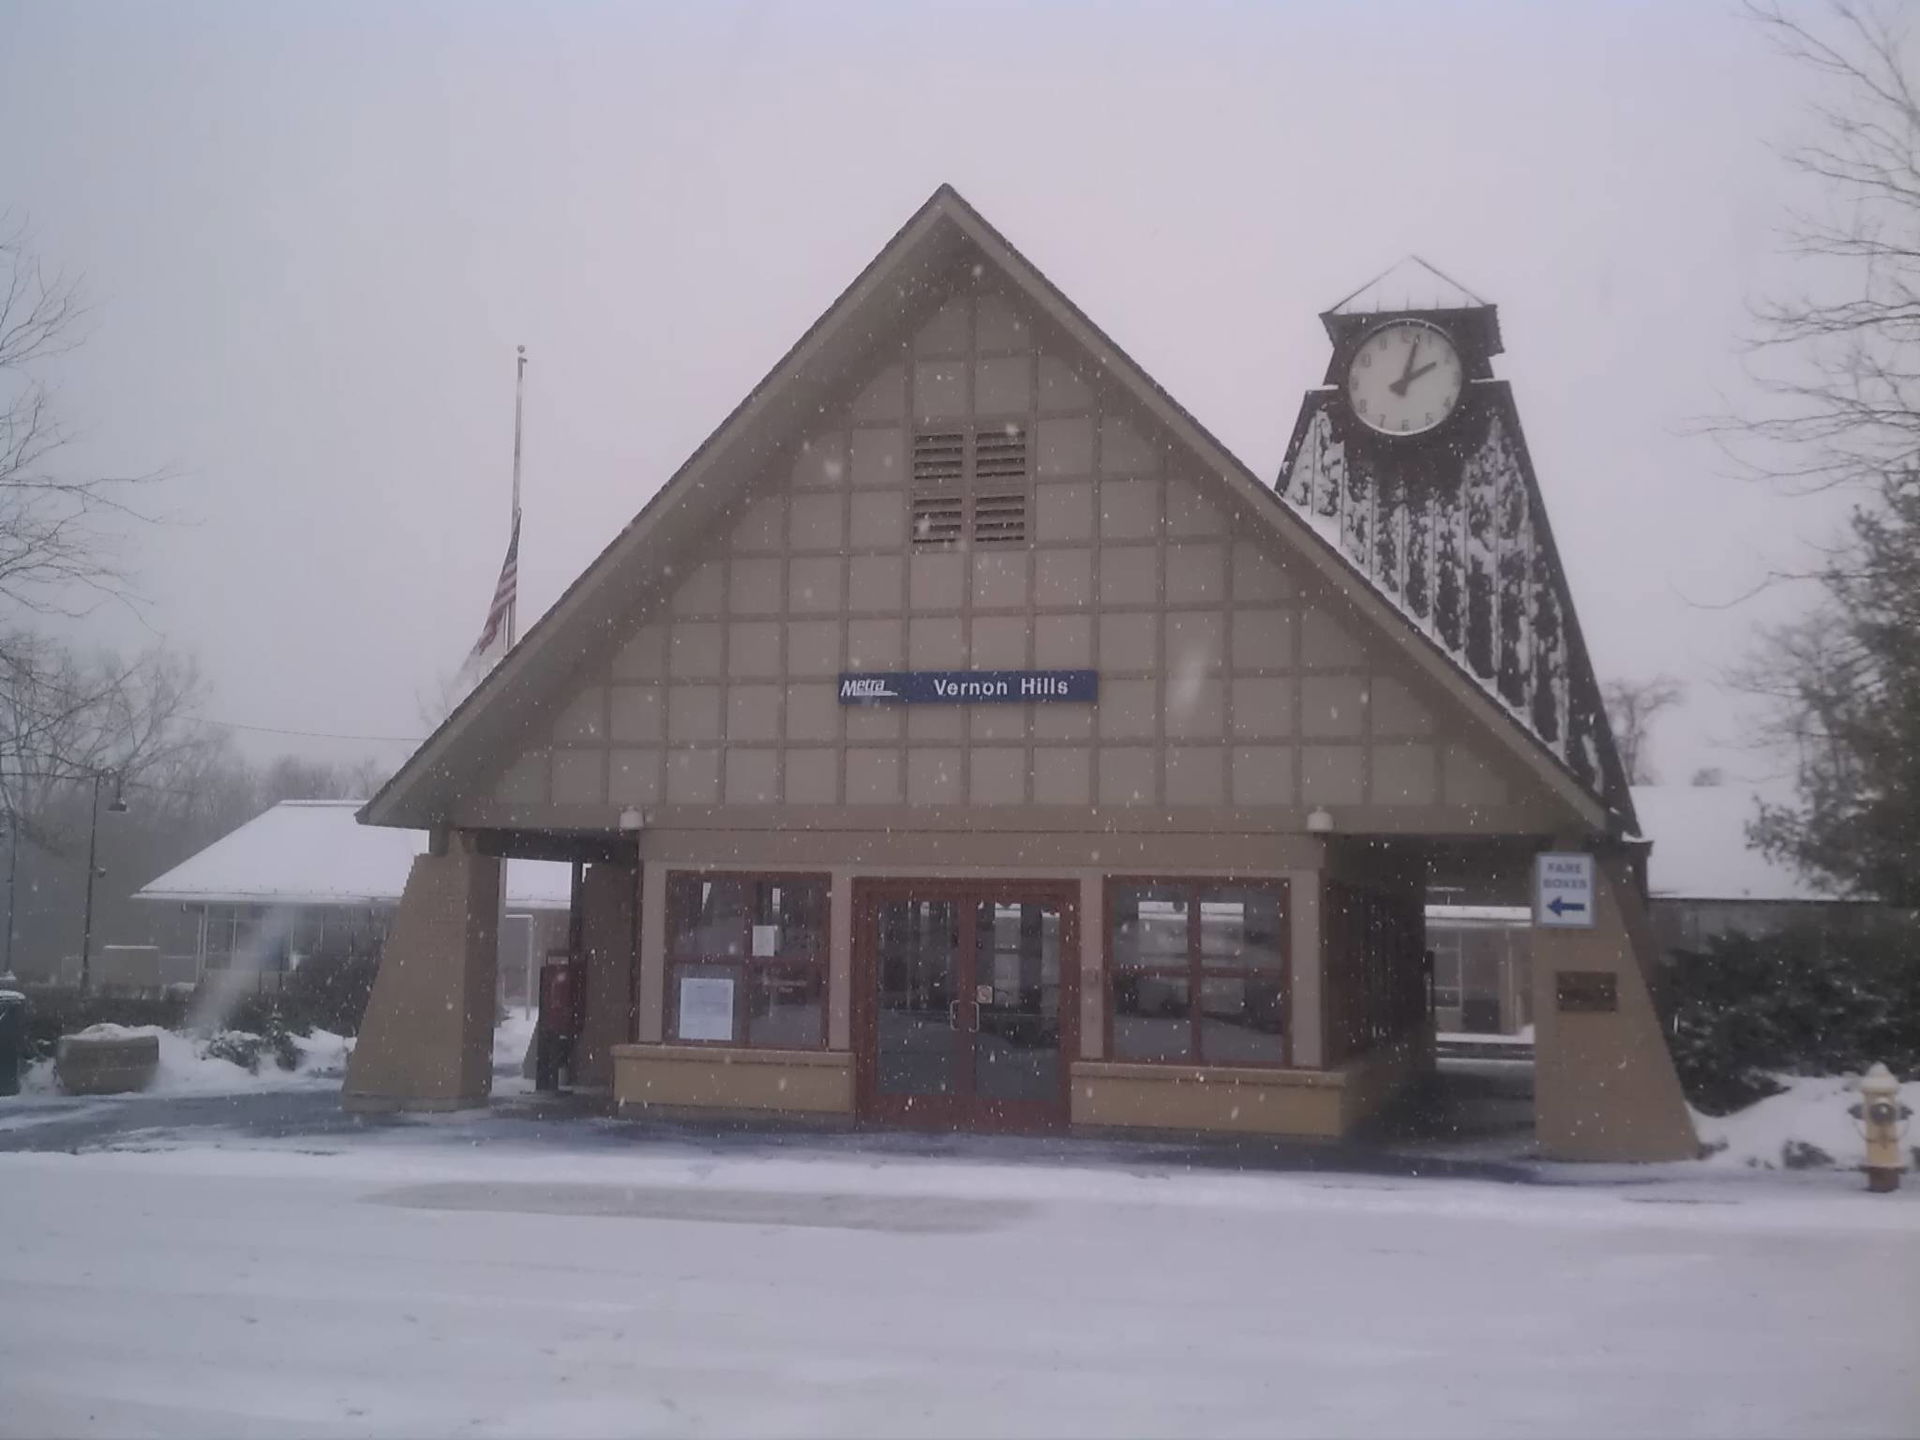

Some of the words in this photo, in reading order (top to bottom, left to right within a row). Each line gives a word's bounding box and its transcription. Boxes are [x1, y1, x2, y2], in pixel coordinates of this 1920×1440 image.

[840, 678, 890, 697] Metra
[933, 678, 1008, 696] Vernon
[1021, 677, 1069, 695] Hills
